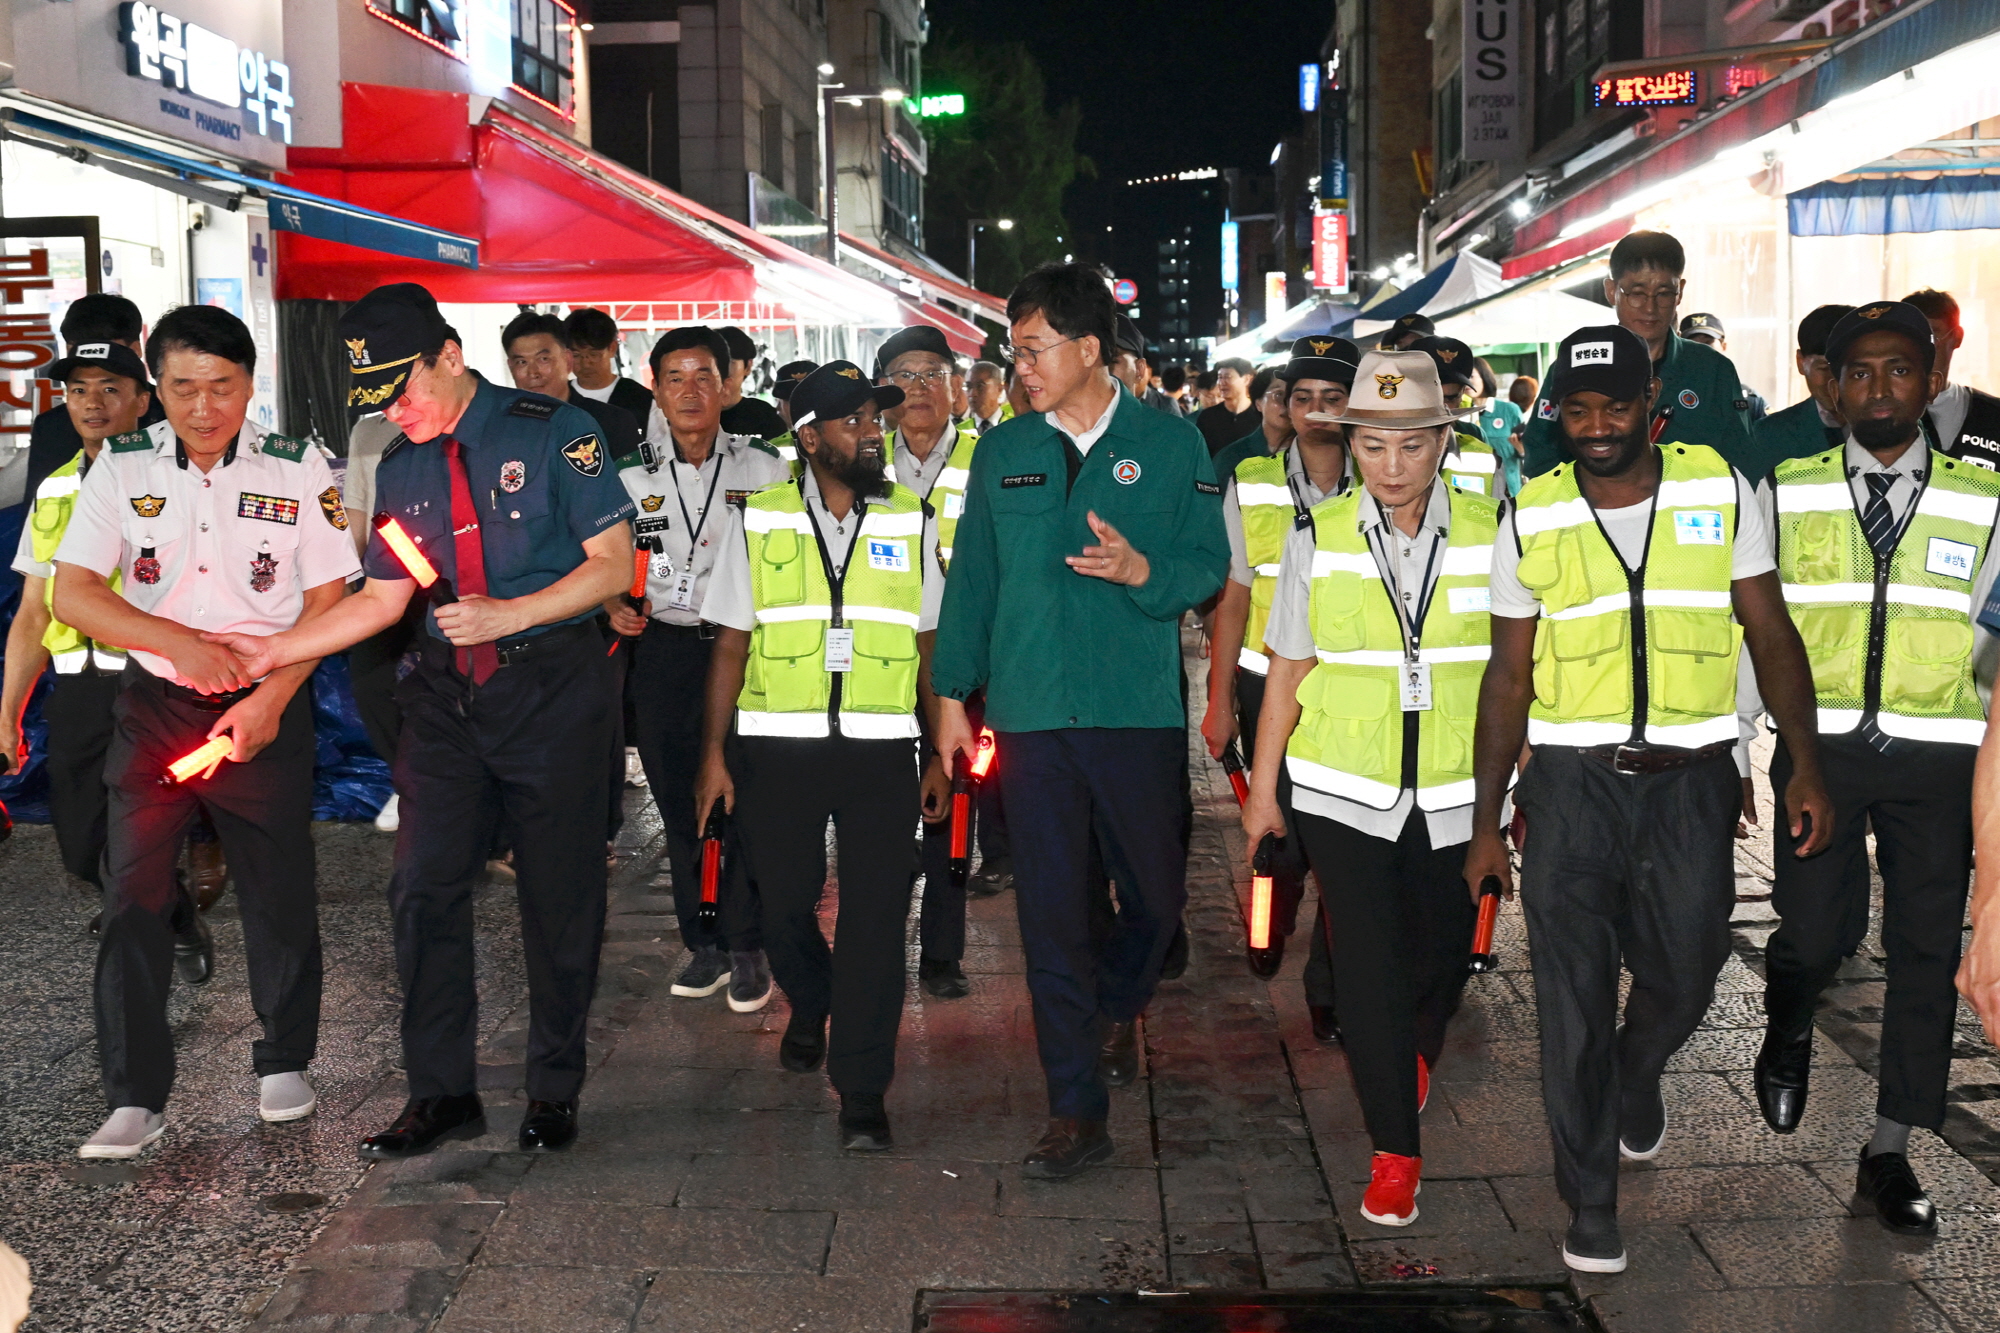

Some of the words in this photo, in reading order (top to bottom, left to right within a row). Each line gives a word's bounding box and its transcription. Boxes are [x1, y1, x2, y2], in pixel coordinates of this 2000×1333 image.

[1476, 0, 1508, 81] US
[131, 1, 187, 89] 원곡
[239, 49, 294, 144] 약국
[195, 111, 241, 141] PHARMACY
[438, 241, 471, 264] PHARMACY
[1575, 347, 1609, 361] 방범순찰
[583, 460, 600, 472] POLICE
